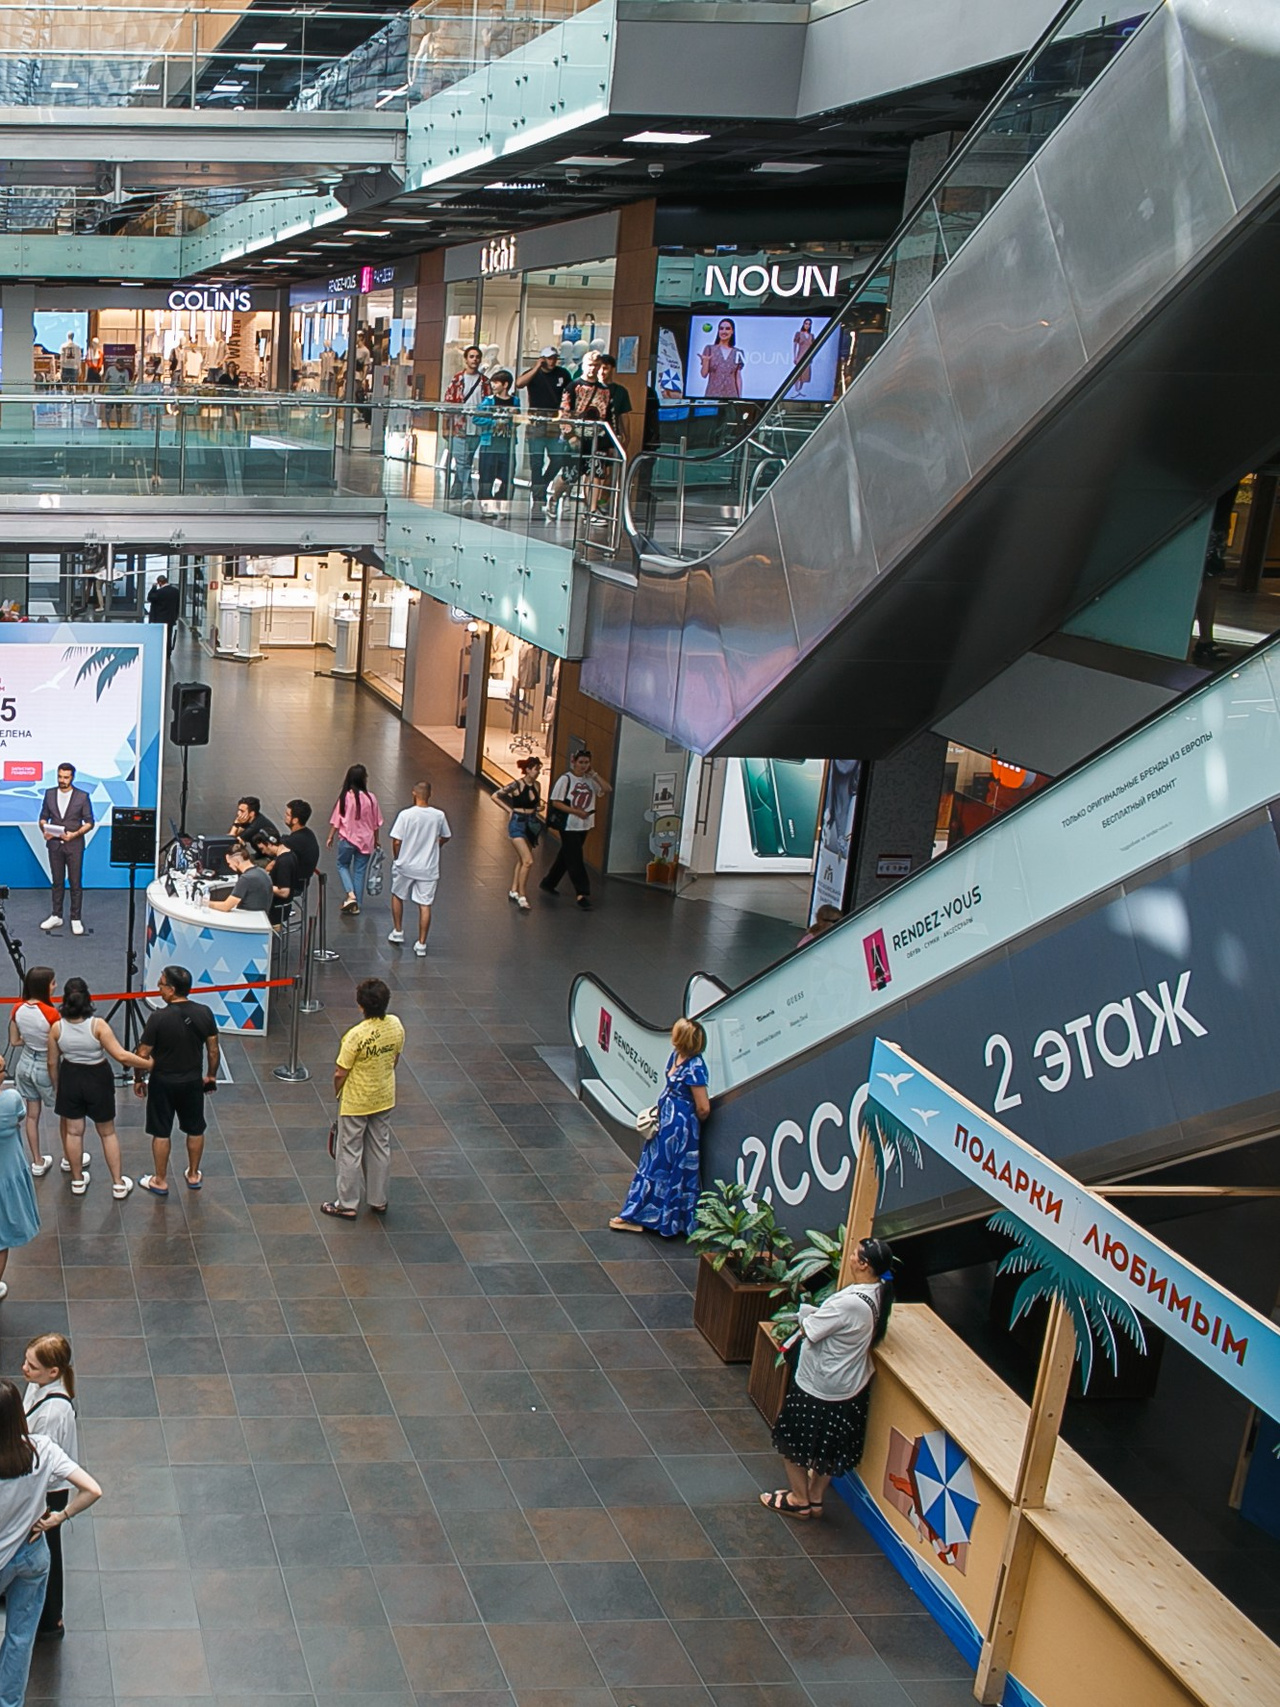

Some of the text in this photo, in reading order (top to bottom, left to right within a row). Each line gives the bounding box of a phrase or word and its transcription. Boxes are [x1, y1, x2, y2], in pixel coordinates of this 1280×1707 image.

[168, 289, 251, 312] COLIN'S
[705, 265, 839, 297] NOUN
[735, 350, 791, 366] NOUN
[0, 729, 33, 738] ЕЛЕНА
[1061, 731, 1214, 828] ТОЛЬКО ОРИГИНАЛЬНЫЕ БРЕНДЫ ИЗ ЕВРОПЫ
[1101, 796, 1147, 829] БЕСПЛАТНЫЙ
[892, 885, 982, 951] RENDEZ-VOUS
[613, 1030, 659, 1084] RENDEZ-VOUS
[984, 970, 1209, 1113] 2 этаж
[954, 1123, 1249, 1367] ПОДАРКИ ЛЮБИМЫМ
